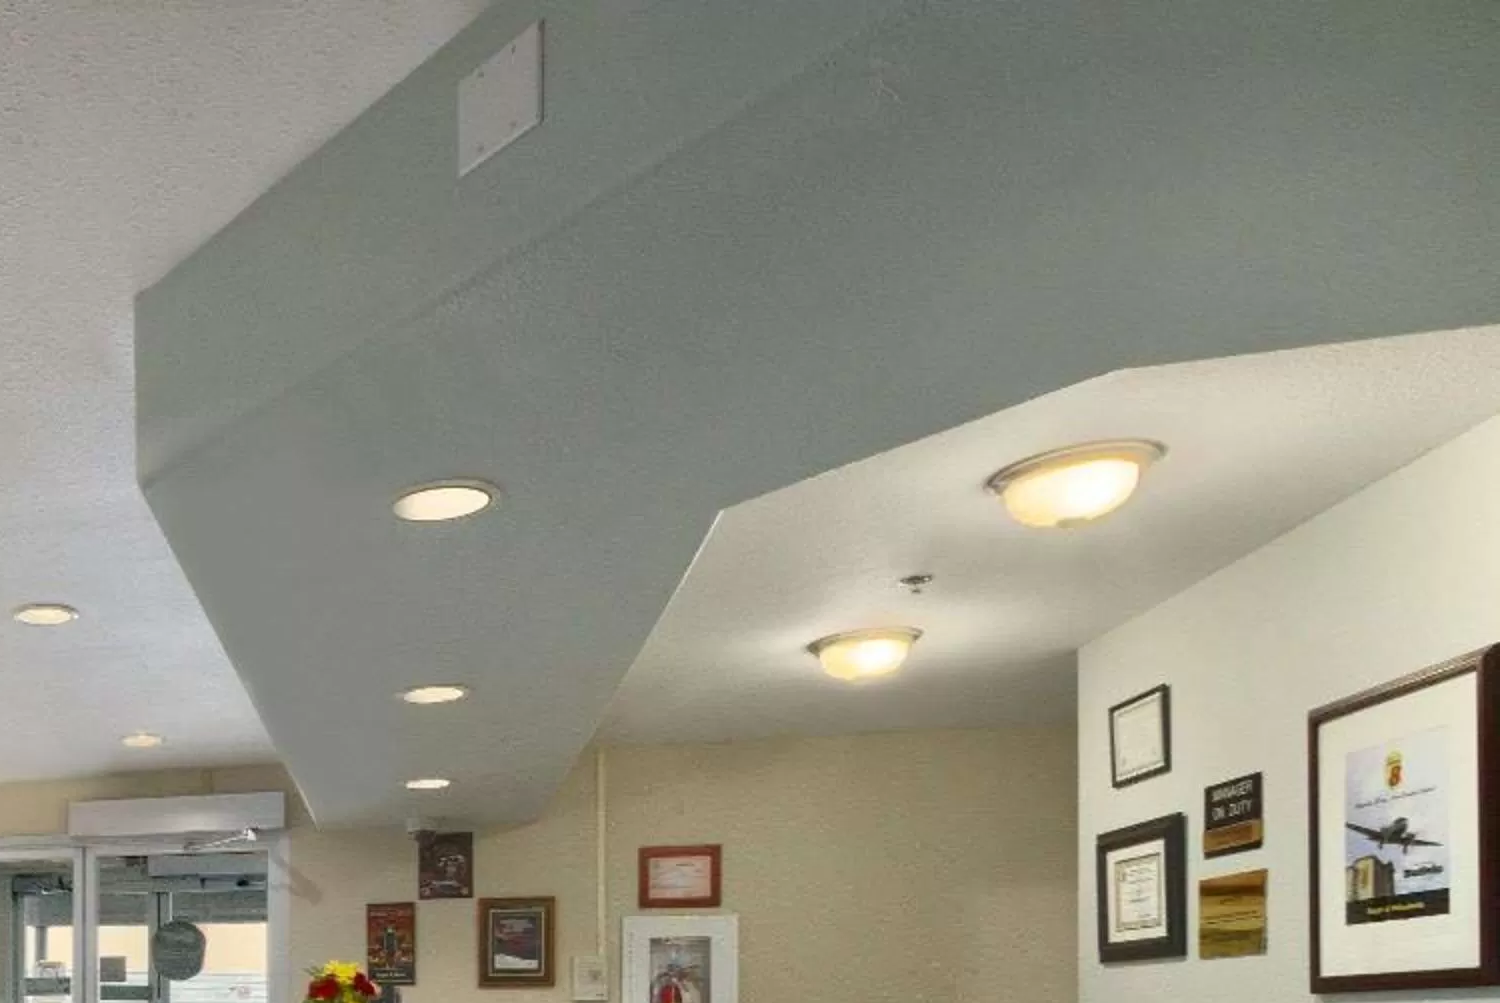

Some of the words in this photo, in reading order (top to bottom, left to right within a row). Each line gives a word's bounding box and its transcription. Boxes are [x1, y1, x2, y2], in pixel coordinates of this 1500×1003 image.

[1211, 779, 1253, 802] MANAGER
[1211, 805, 1225, 821] ON
[1228, 799, 1252, 817] DUTY
